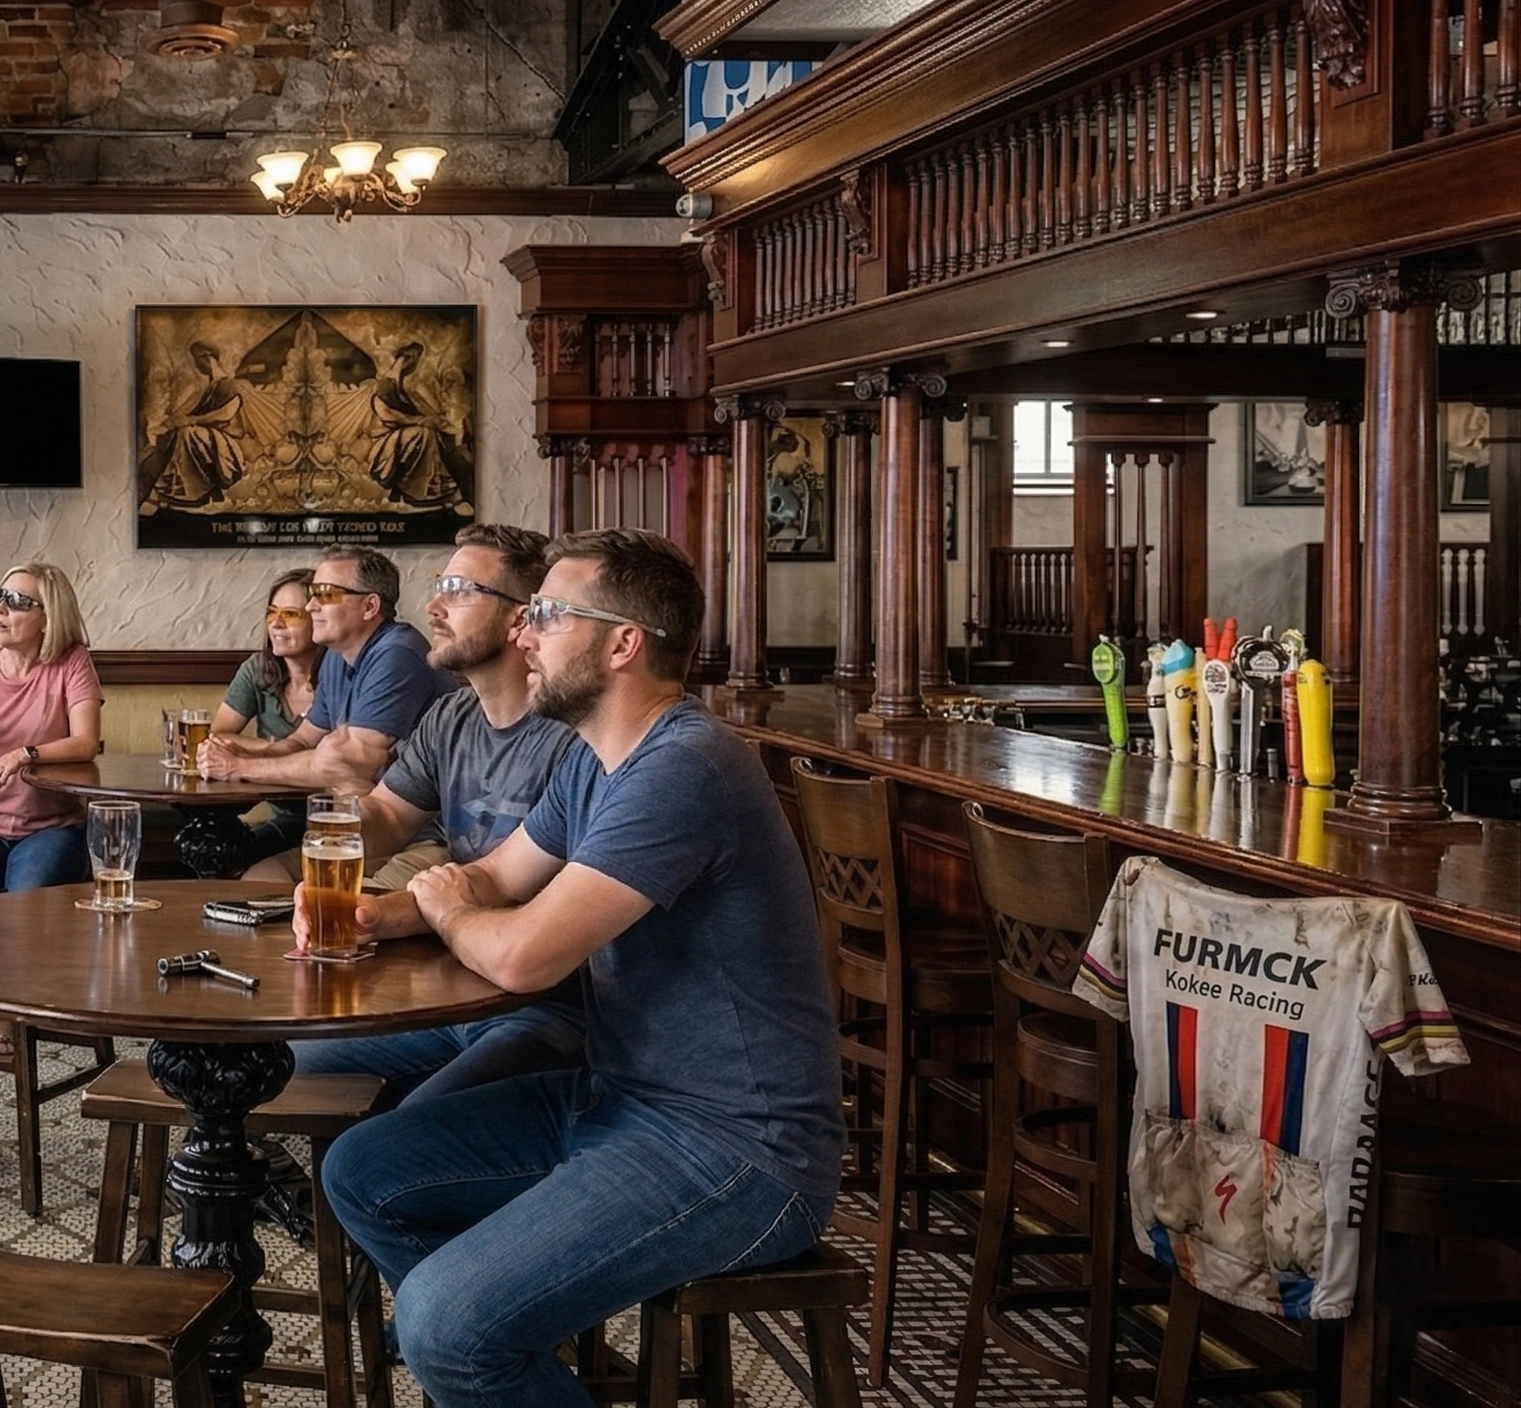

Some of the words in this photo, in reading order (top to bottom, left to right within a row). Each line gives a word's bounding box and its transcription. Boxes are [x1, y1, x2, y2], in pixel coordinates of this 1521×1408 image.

[1154, 928, 1327, 990] FURMCK
[1166, 969, 1222, 999] Kokee
[1229, 983, 1305, 1021] Racing
